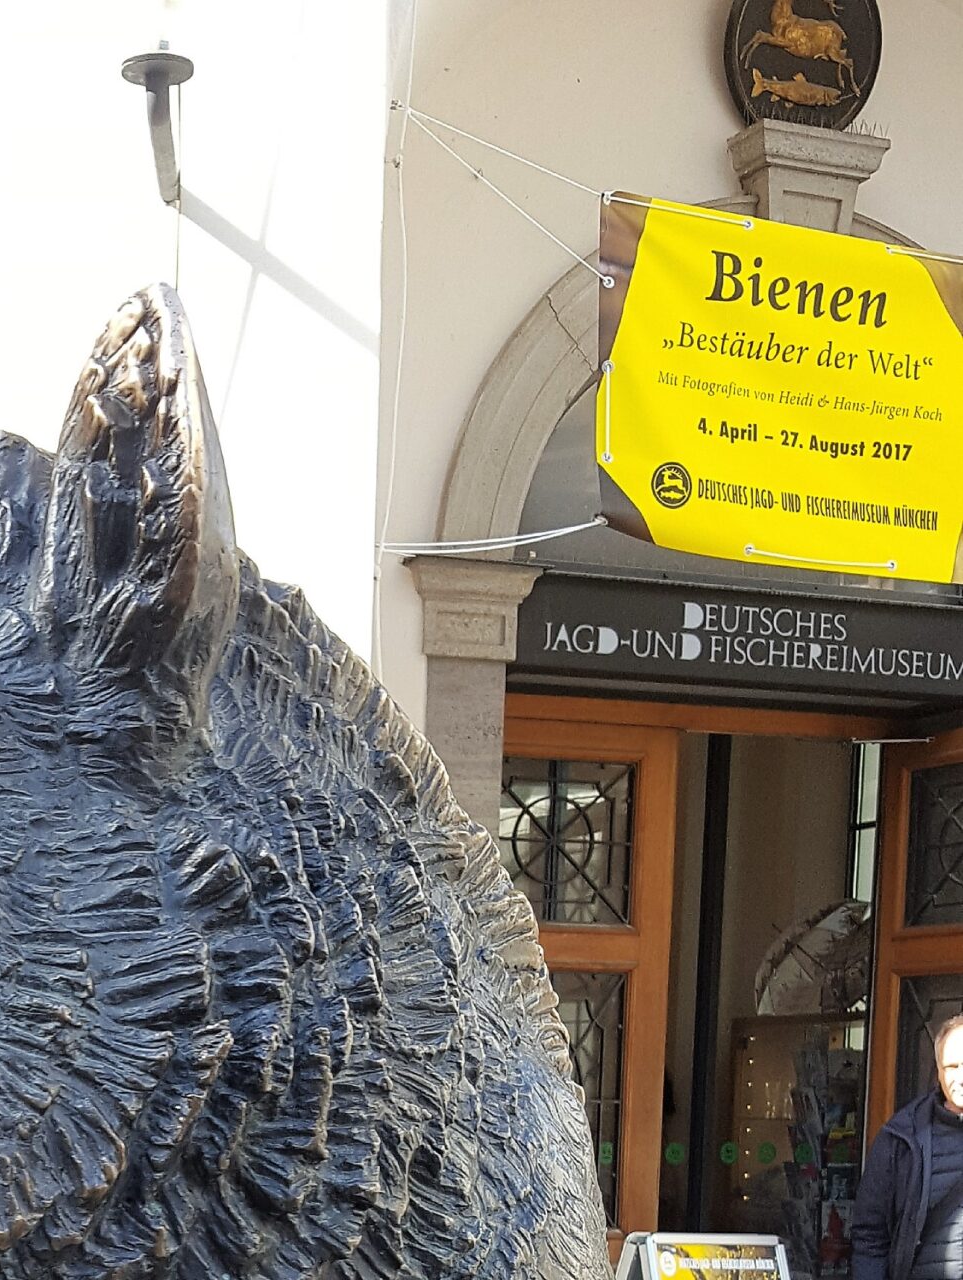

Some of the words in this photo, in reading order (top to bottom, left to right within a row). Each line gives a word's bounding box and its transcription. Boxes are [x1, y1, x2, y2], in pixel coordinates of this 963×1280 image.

[705, 250, 888, 329] Bienen
[662, 321, 809, 364] „Bestäuber
[817, 340, 859, 371] der
[868, 349, 934, 381] Welt“
[657, 370, 678, 387] Mit
[682, 375, 750, 399] Fotografien
[753, 388, 774, 403] von
[778, 390, 813, 408] Heidi
[817, 397, 830, 408] &
[833, 396, 910, 420] Hans-Jürgen
[913, 405, 943, 422] Koch
[697, 417, 713, 435] 4.
[719, 420, 758, 444] April
[780, 429, 803, 449] 27.
[809, 434, 866, 459] August
[871, 441, 913, 462] 2017
[697, 477, 748, 506] DEUTSCHES
[750, 486, 779, 511] JAGD-
[781, 491, 801, 513] UND
[806, 495, 891, 526] FISCHEREIMUSEUM
[893, 504, 939, 531] MÜNCHEN
[681, 601, 847, 642] DEUTSCHES
[708, 634, 963, 681] FISCHEREIMUSEUM
